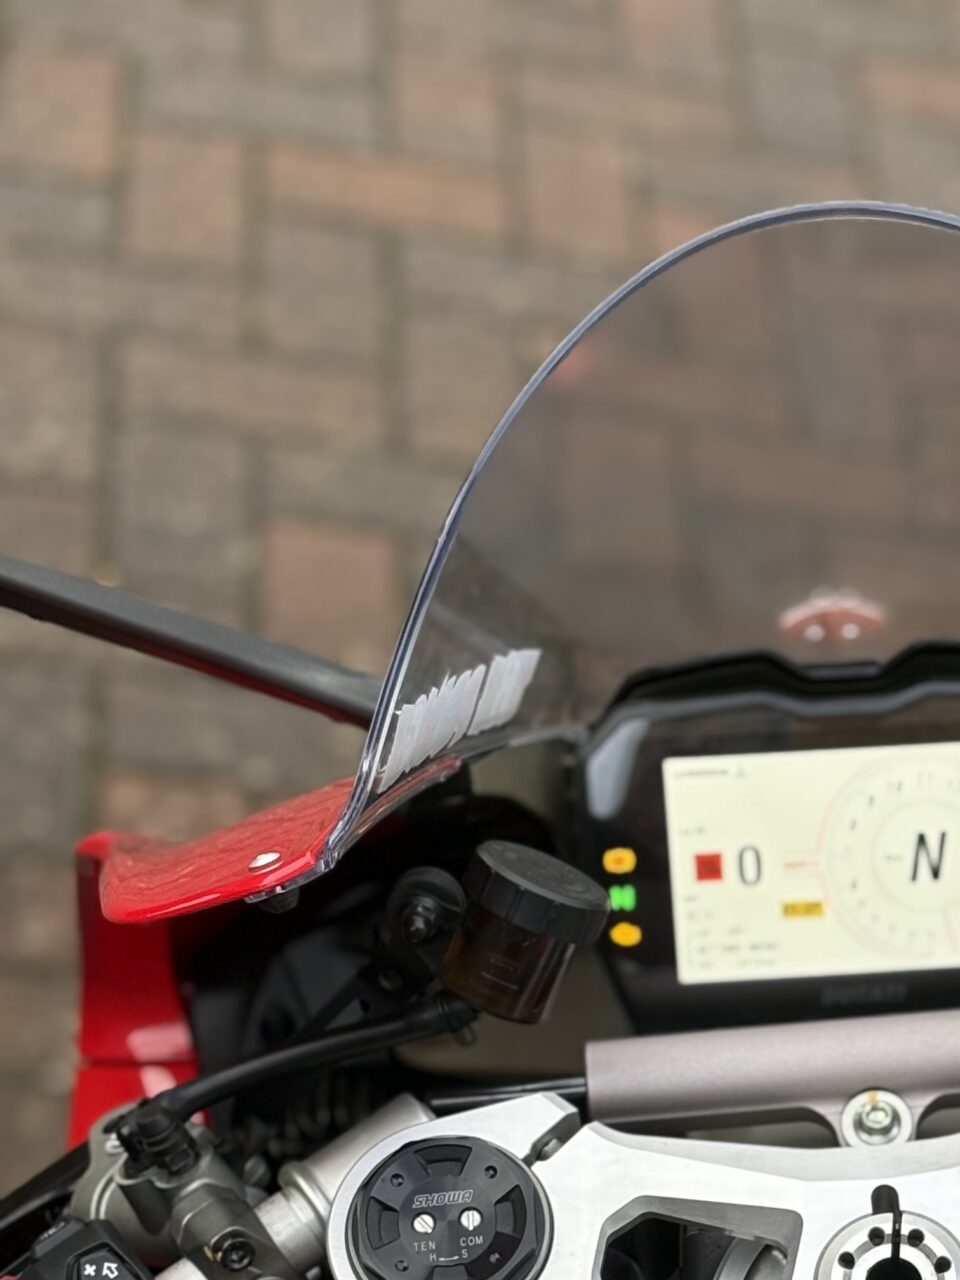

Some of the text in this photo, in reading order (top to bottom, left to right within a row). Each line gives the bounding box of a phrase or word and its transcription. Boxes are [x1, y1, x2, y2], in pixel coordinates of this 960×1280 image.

[910, 831, 947, 883] N
[412, 1189, 473, 1208] SHOWA
[413, 1236, 484, 1251] TEN COM
[430, 1249, 468, 1262] H S
